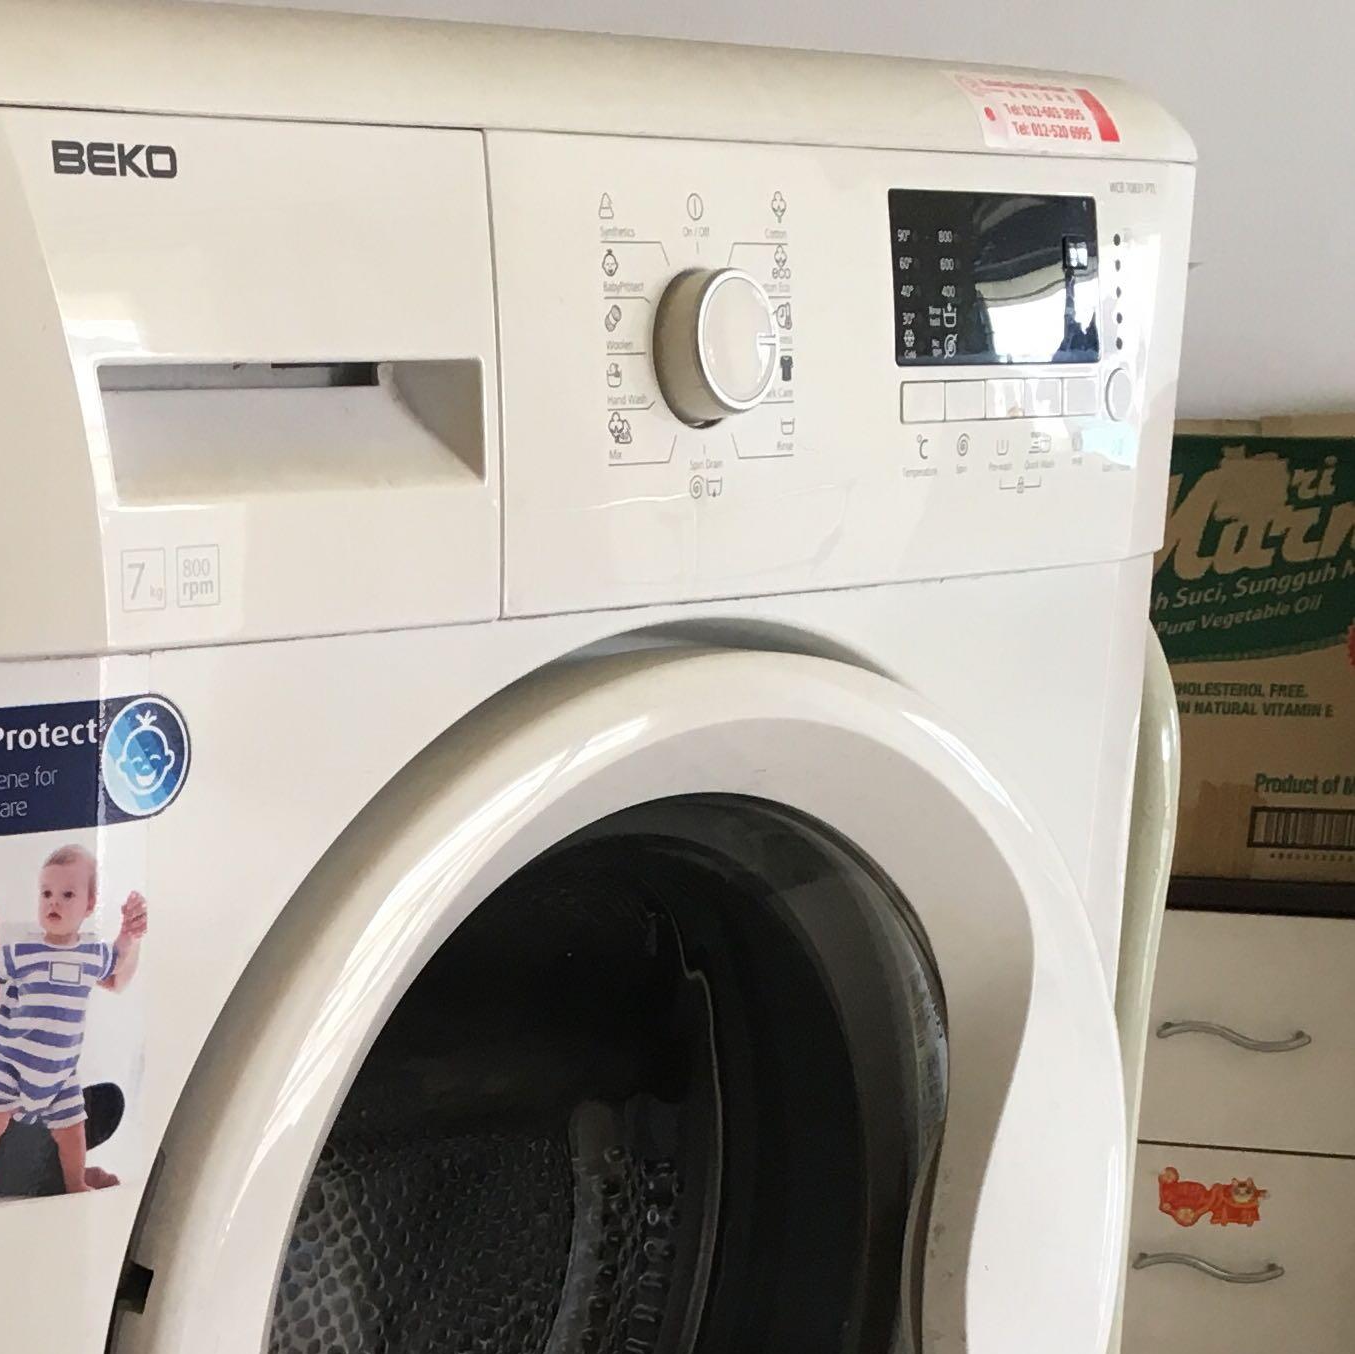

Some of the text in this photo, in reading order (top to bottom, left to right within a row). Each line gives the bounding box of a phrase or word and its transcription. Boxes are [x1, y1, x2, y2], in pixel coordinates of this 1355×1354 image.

[1003, 103, 1022, 116] Tel:
[1011, 121, 1031, 136] Tel:
[1031, 122, 1068, 139] 012-520
[51, 140, 177, 178] BEKO
[600, 225, 636, 240] Synthetics
[682, 226, 693, 238] On
[698, 226, 710, 238] Off
[938, 230, 953, 243] 800
[940, 257, 955, 271] 600
[772, 268, 791, 280] eco
[941, 285, 956, 298] 400
[607, 394, 627, 405] Hand
[609, 449, 622, 460] Mix
[182, 558, 211, 578] 800
[128, 561, 145, 600] 7
[1173, 582, 1227, 609] Suci,
[1232, 562, 1337, 598] Sungguh
[182, 580, 214, 600] rpm
[1157, 593, 1323, 636] Pure Vegetable Oil
[1194, 701, 1258, 716] NATURAL
[1262, 703, 1322, 717] VITAMIN
[1324, 704, 1335, 718] E
[34, 765, 58, 787] for
[1254, 772, 1319, 794] Product
[1321, 774, 1341, 795] of
